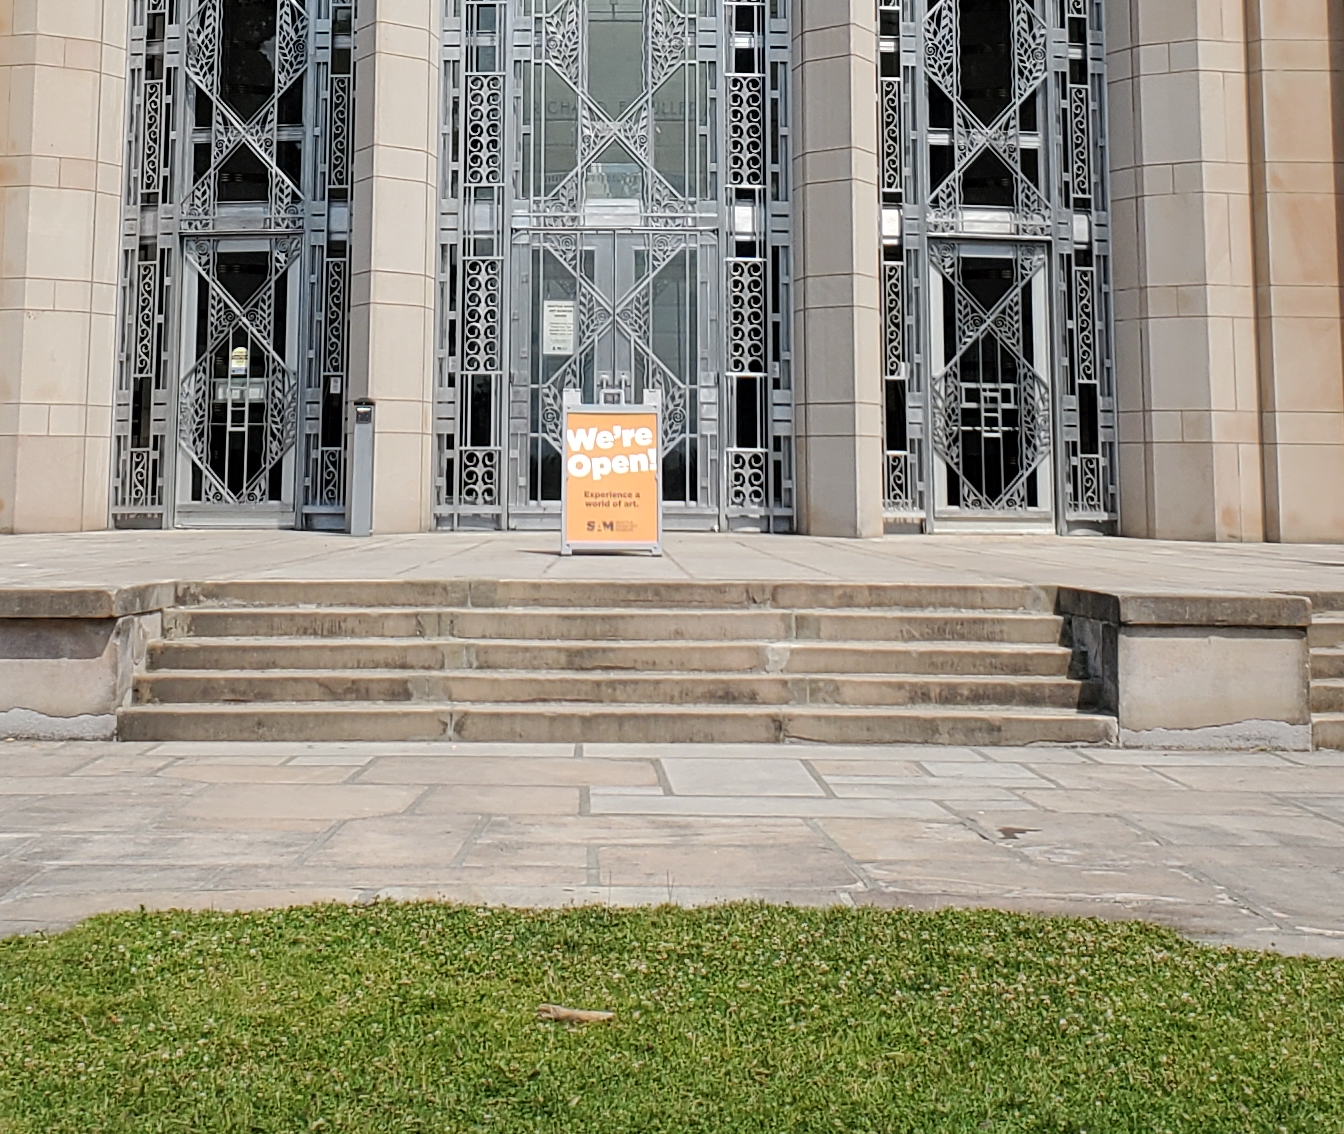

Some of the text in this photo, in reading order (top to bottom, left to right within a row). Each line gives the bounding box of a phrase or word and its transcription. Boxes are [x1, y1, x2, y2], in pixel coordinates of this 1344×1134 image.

[567, 425, 652, 452] We're
[567, 448, 657, 481] Open!
[584, 490, 632, 499] Experience
